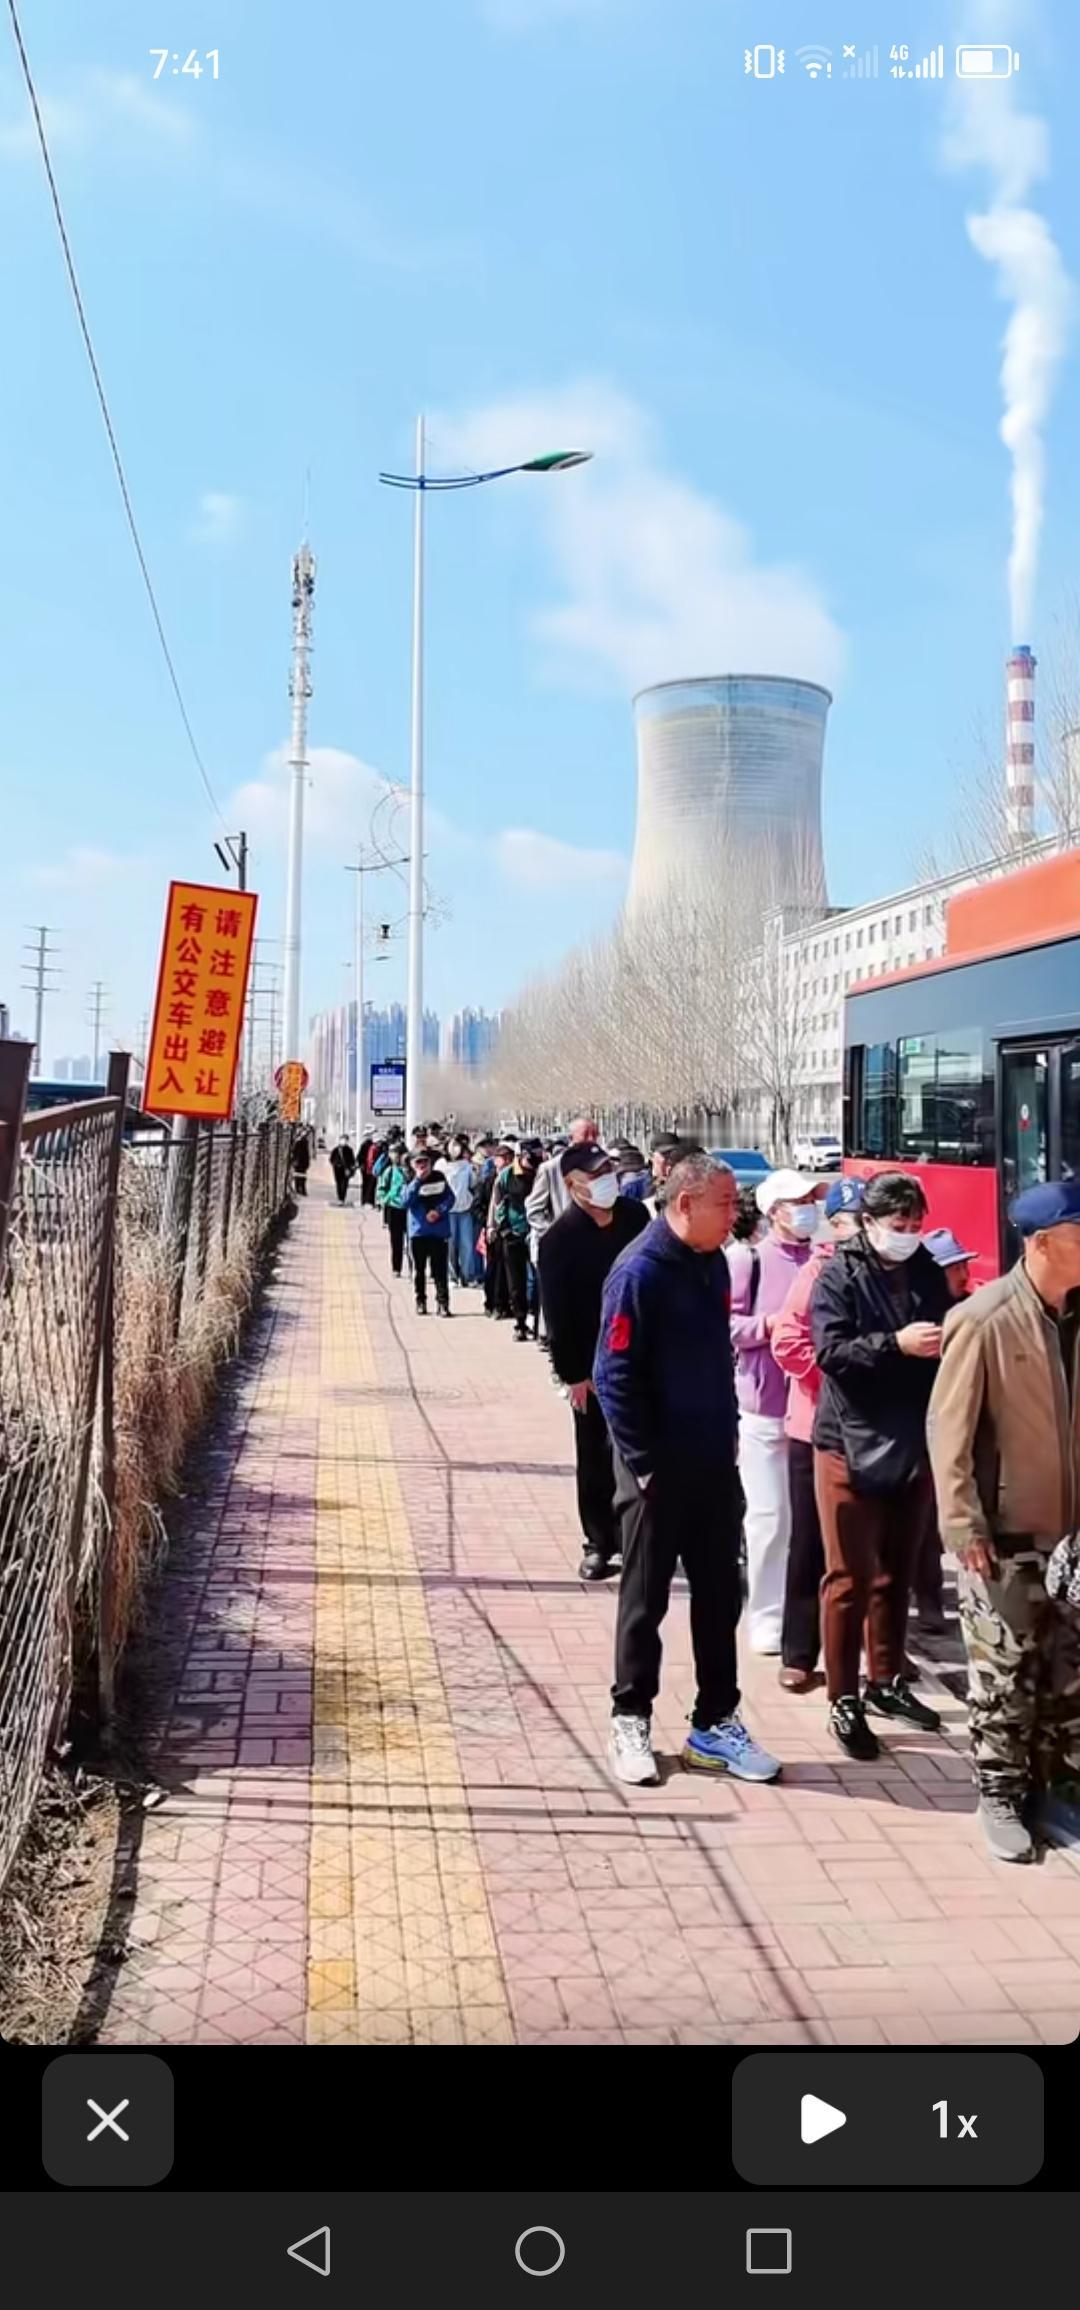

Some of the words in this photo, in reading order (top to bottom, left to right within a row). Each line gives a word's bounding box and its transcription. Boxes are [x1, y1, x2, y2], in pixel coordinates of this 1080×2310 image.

[158, 902, 207, 1094] 有公交车出入
[195, 908, 242, 1097] 请注意避让
